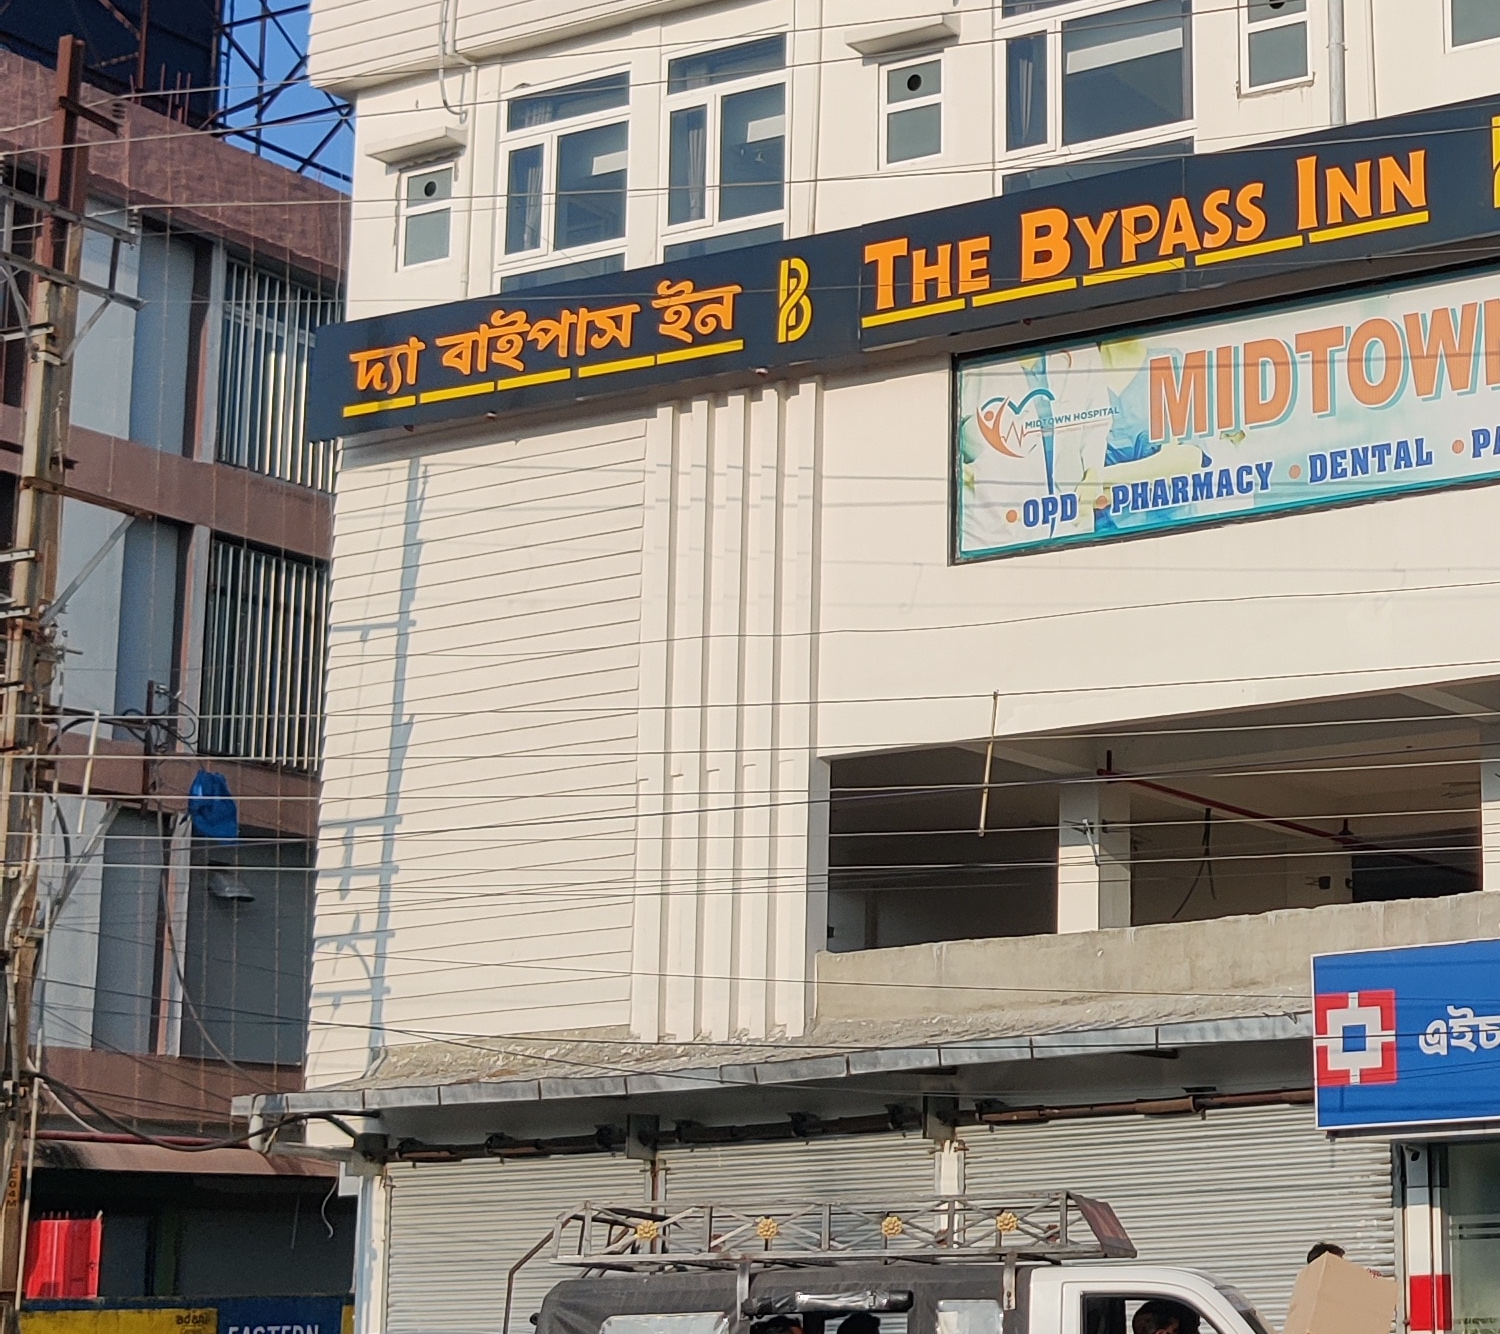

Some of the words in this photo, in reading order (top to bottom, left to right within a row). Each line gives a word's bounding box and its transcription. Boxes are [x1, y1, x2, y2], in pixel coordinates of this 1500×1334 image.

[864, 235, 991, 309] THE
[1020, 182, 1266, 282] BYPASS
[1297, 150, 1427, 230] INN
[436, 304, 640, 375] বাইপাস
[651, 279, 741, 342] ইন
[1025, 414, 1071, 430] MIDTOWN
[1074, 406, 1121, 422] HOSPITAL
[1022, 493, 1078, 528] OPD
[1110, 462, 1274, 516] PHARMACY
[1308, 437, 1434, 486] DENTAL
